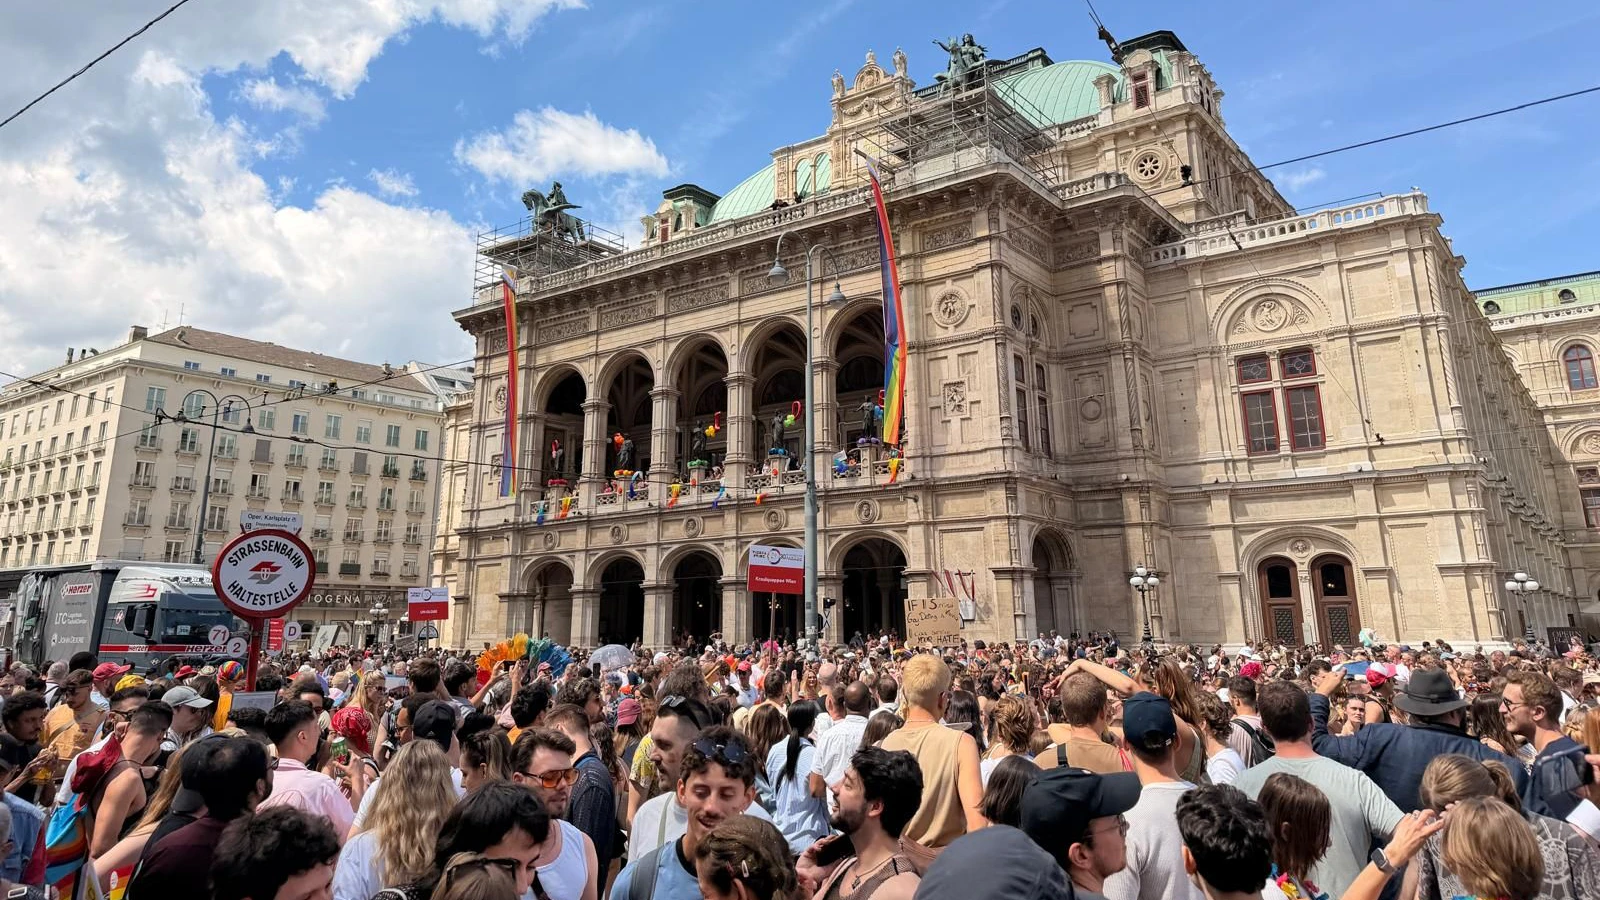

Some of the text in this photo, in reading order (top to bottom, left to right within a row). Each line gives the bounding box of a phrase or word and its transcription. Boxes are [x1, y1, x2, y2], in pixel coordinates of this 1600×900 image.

[264, 514, 291, 522] Karlsplatz
[228, 539, 305, 569] STRASSENBAHN
[227, 580, 299, 606] HALTESTELLE
[307, 594, 361, 604] IOGENA
[907, 599, 918, 611] IF
[54, 612, 68, 625] LTC
[213, 629, 227, 641] 71
[288, 626, 296, 636] D
[937, 634, 960, 644] HATE
[233, 642, 242, 653] 2
